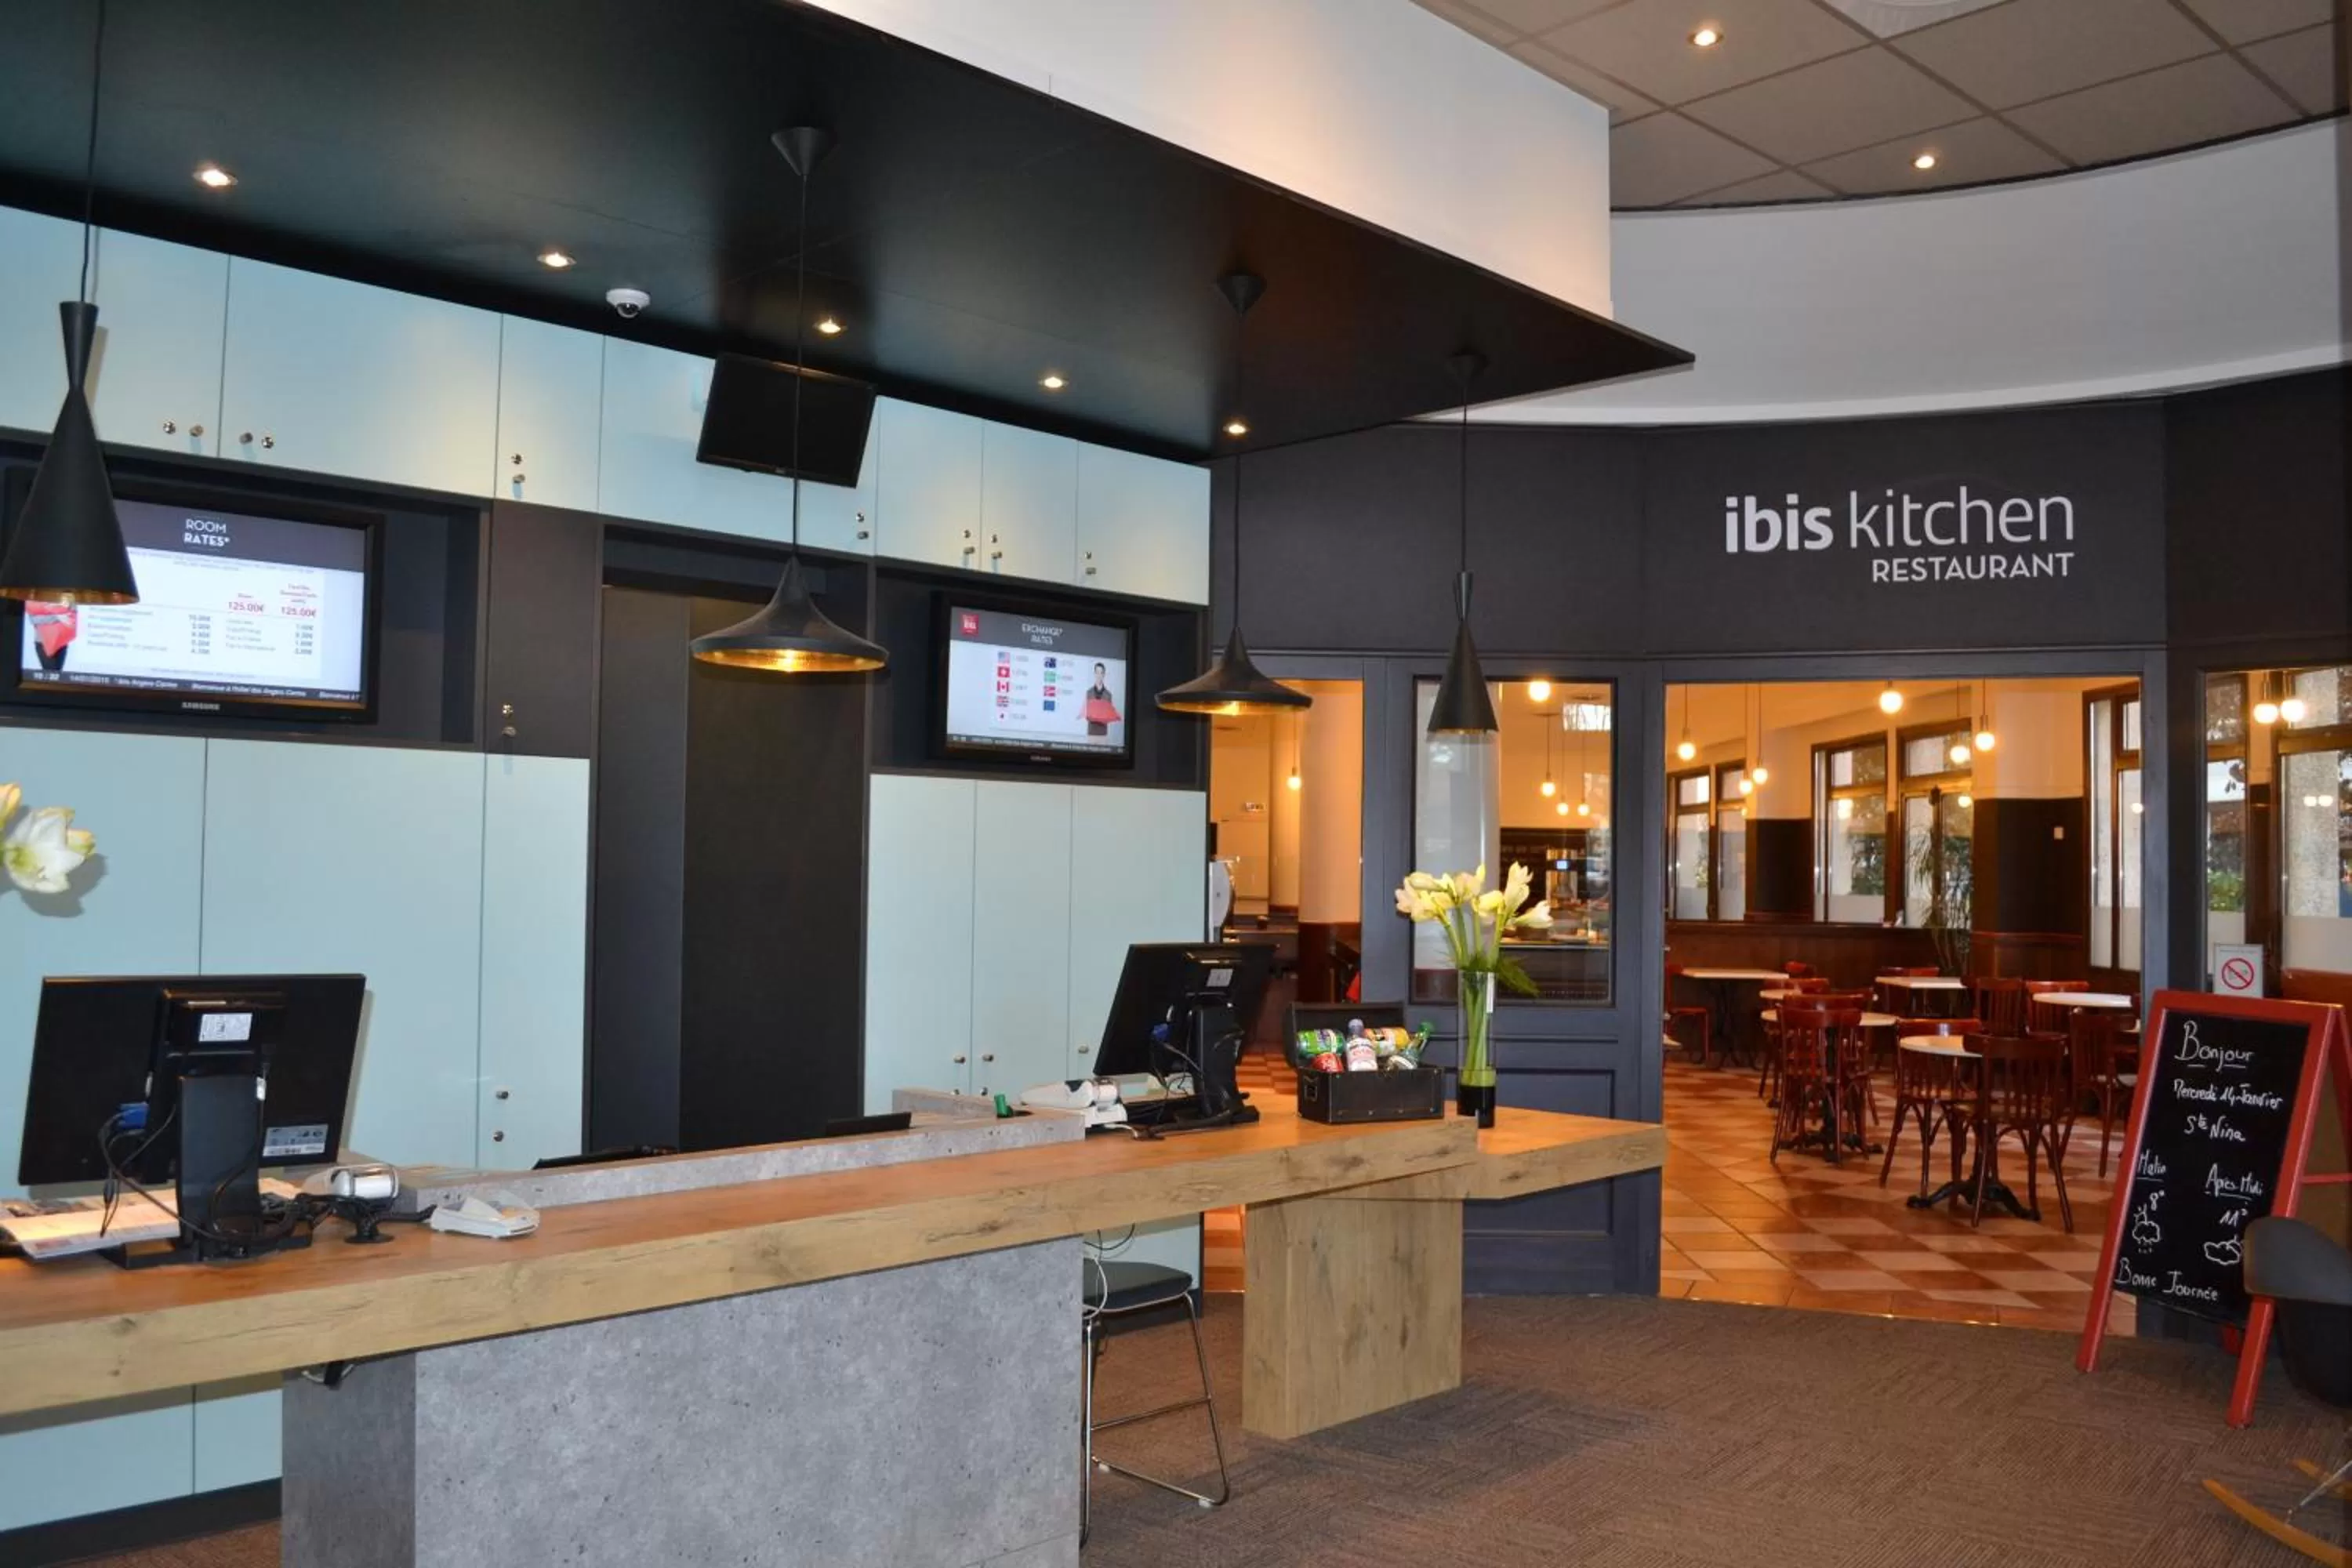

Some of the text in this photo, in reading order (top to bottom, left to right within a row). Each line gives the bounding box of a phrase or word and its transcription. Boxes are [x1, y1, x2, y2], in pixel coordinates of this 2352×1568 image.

[185, 518, 227, 533] ROOM
[1726, 486, 2074, 553] ibis kitchen
[1872, 553, 2074, 583] RESTAURANT
[2173, 1020, 2255, 1073] Bonjour
[2209, 1115, 2246, 1142] Nina
[2114, 1257, 2218, 1301] Bonne Journée
